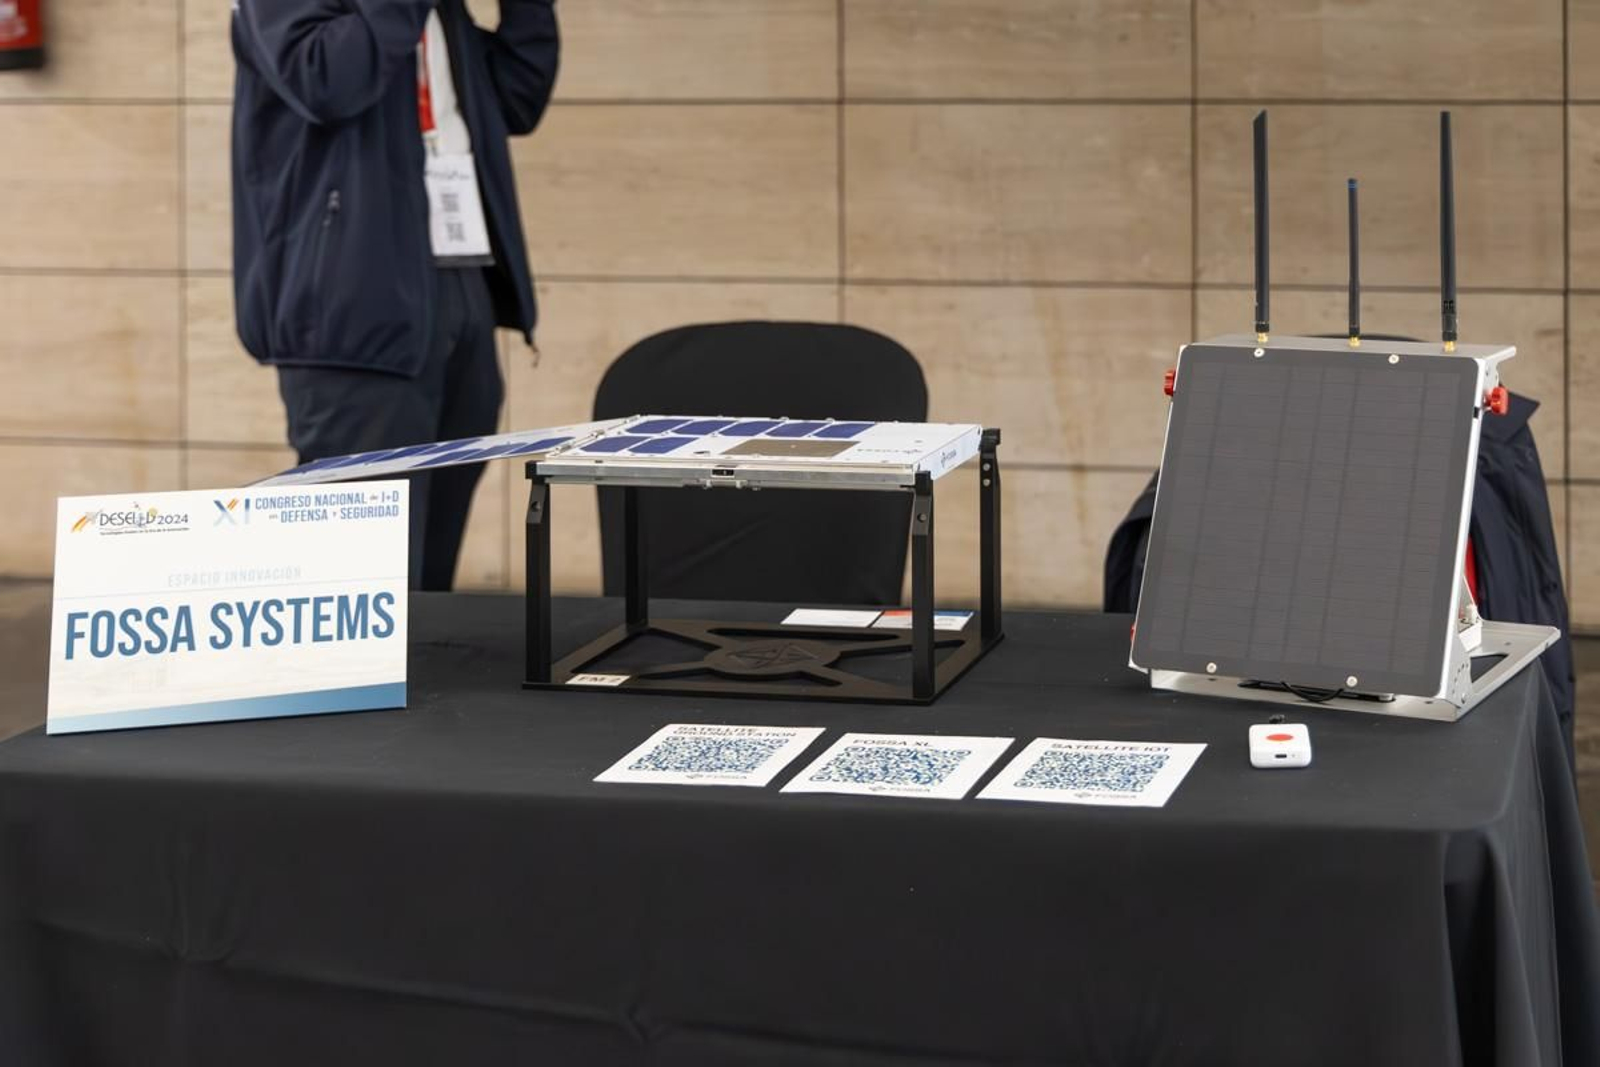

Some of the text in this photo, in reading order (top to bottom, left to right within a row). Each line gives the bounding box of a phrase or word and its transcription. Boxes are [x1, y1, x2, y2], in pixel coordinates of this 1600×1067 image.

[255, 495, 311, 510] CONGRESO
[315, 492, 367, 507] NACIONAL
[381, 490, 400, 503] I+D
[157, 514, 189, 525] 2024
[280, 509, 328, 523] DEFENSA
[340, 505, 400, 520] SEGURIDAD
[168, 571, 220, 588] ESPACIO
[65, 591, 395, 660] FOSSA SYSTEMS
[1052, 743, 1139, 751] SATELLITE
